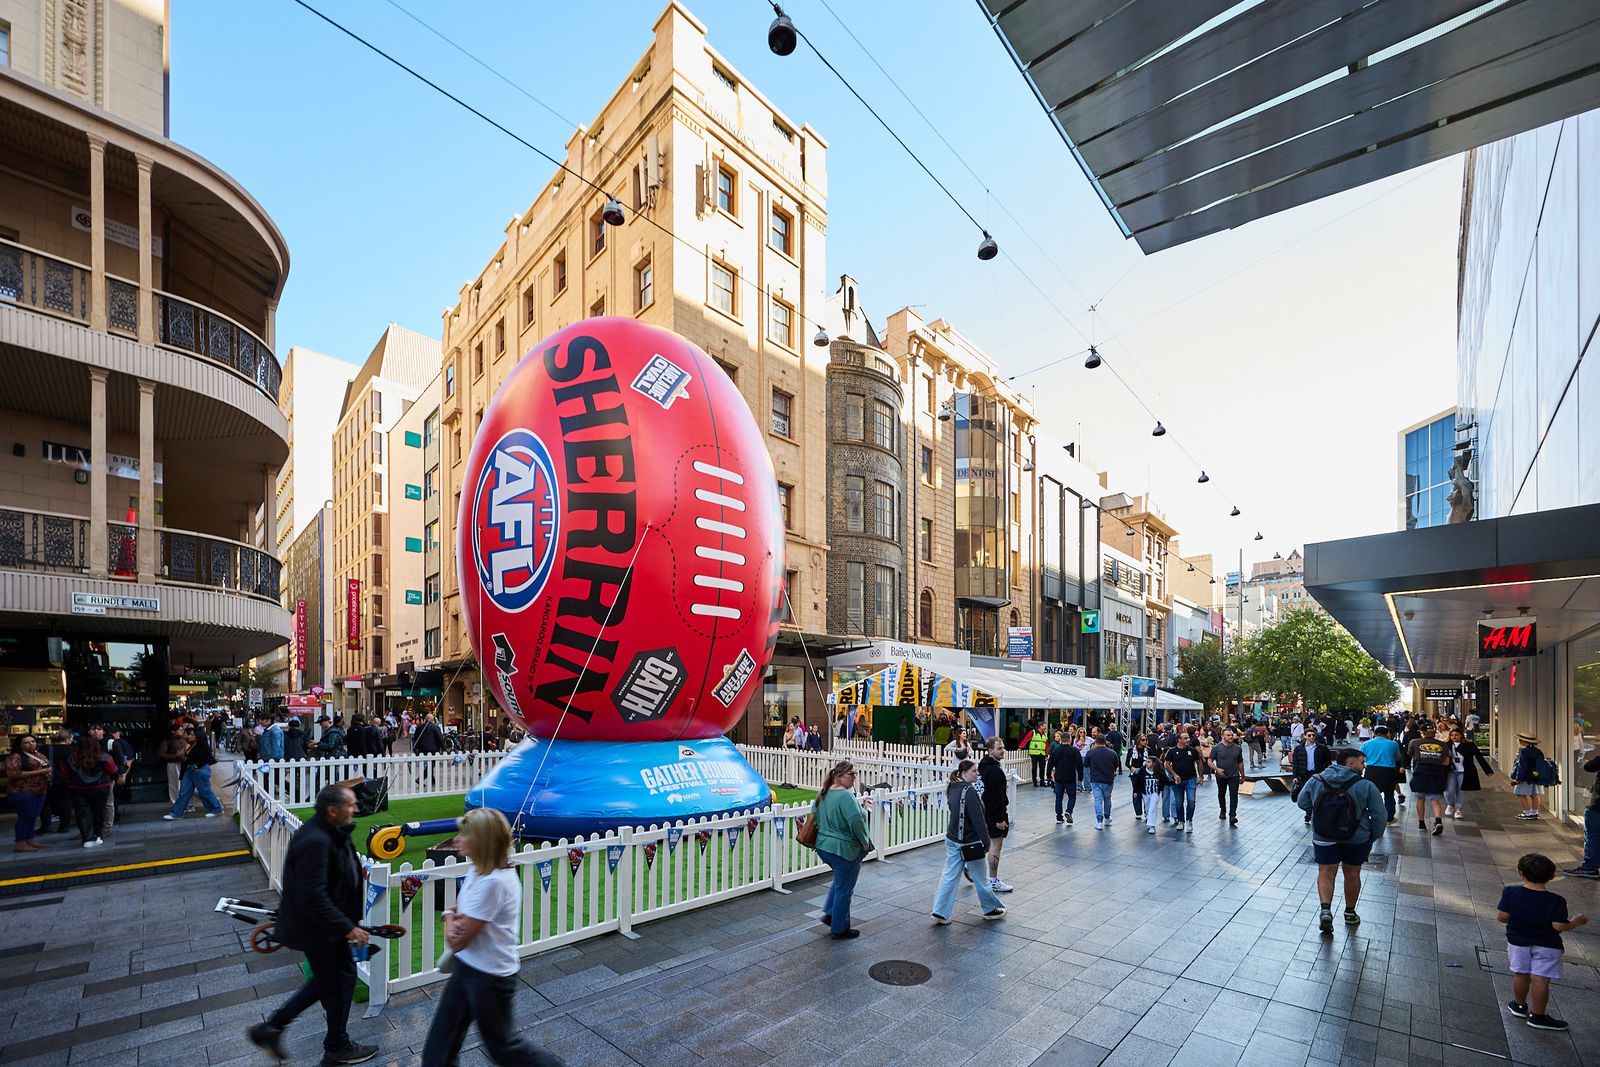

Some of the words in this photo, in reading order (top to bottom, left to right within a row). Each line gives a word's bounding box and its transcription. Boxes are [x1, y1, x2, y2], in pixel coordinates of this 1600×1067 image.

[636, 358, 669, 389] OVAL
[648, 364, 681, 401] ADELAIDE
[957, 468, 996, 478] DENTIST
[491, 449, 536, 596] AFL
[535, 336, 637, 724] SHERRIN
[90, 596, 127, 606] RUNDLE
[131, 599, 155, 608] MALL
[538, 595, 553, 645] KANGAROO
[1482, 625, 1532, 650] H&M
[531, 646, 542, 675] BRAND
[890, 646, 911, 660] Bailey
[911, 648, 932, 660] Nelson
[720, 656, 751, 699] ADELAIDE
[725, 664, 754, 703] OVAL
[1044, 665, 1078, 676] SKECHERS
[500, 673, 524, 718] SOUTH
[620, 656, 678, 717] GATH
[118, 721, 151, 729] WANG
[640, 762, 701, 789] GATHER
[659, 780, 706, 793] FESTIVAL
